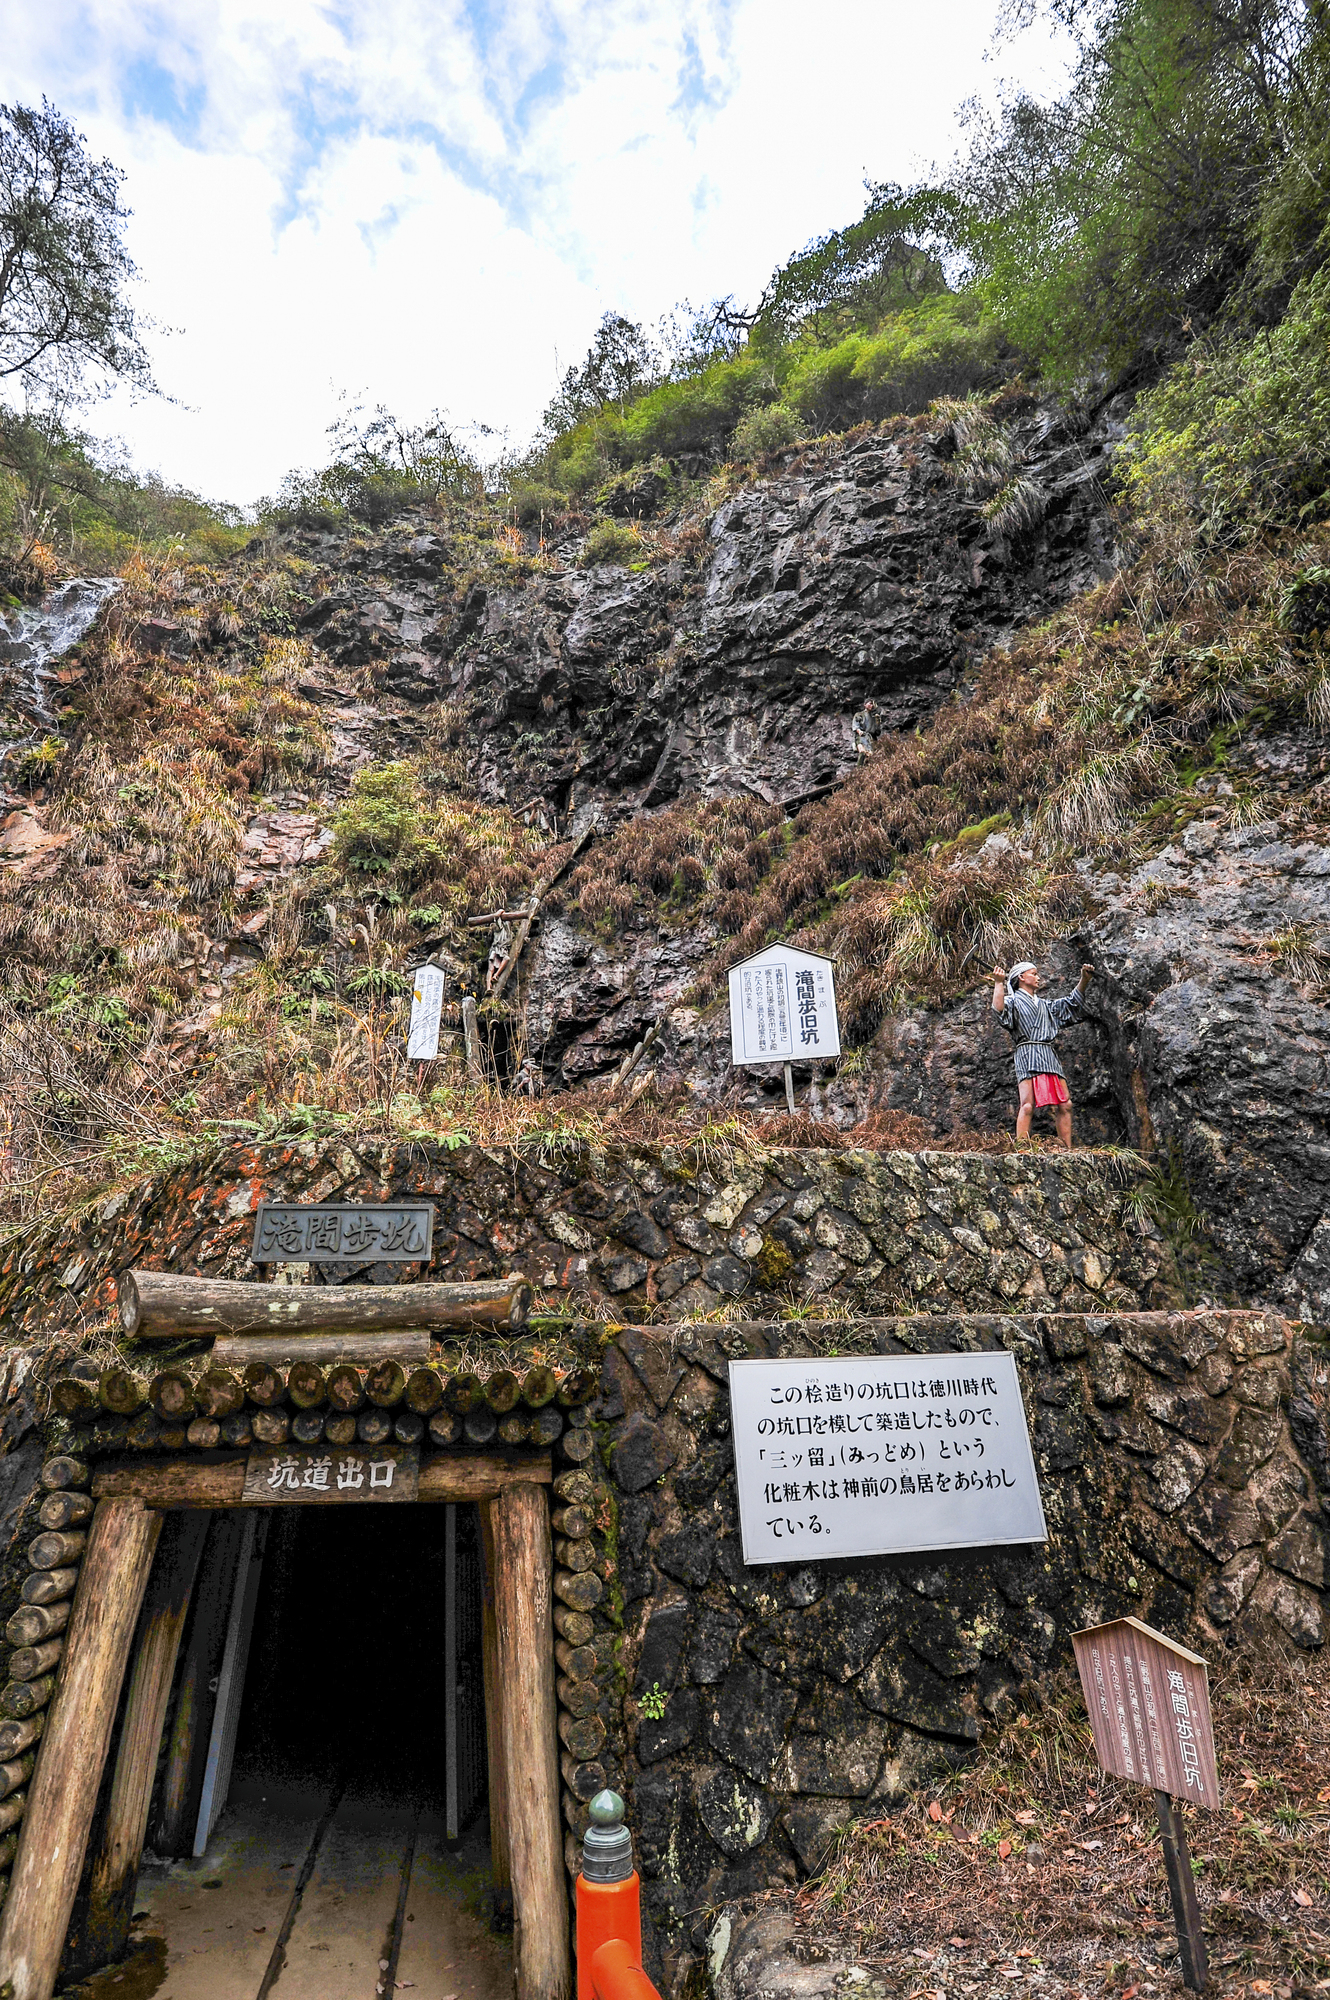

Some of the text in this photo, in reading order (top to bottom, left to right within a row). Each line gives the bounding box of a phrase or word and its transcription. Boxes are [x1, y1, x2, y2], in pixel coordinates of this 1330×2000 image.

[795, 970, 820, 1045] 滝間歩旧坑
[769, 1377, 997, 1404] この桧造りの坑口は徳川時代
[757, 1407, 1000, 1436] の坑口を模して築造したもので、
[267, 1455, 397, 1491] 坑道出口
[763, 1468, 1016, 1504] 化粧木は神前の鳥居をあらわし
[766, 1514, 831, 1538] ている。
[1167, 1669, 1203, 1791] 滝間歩旧坑
